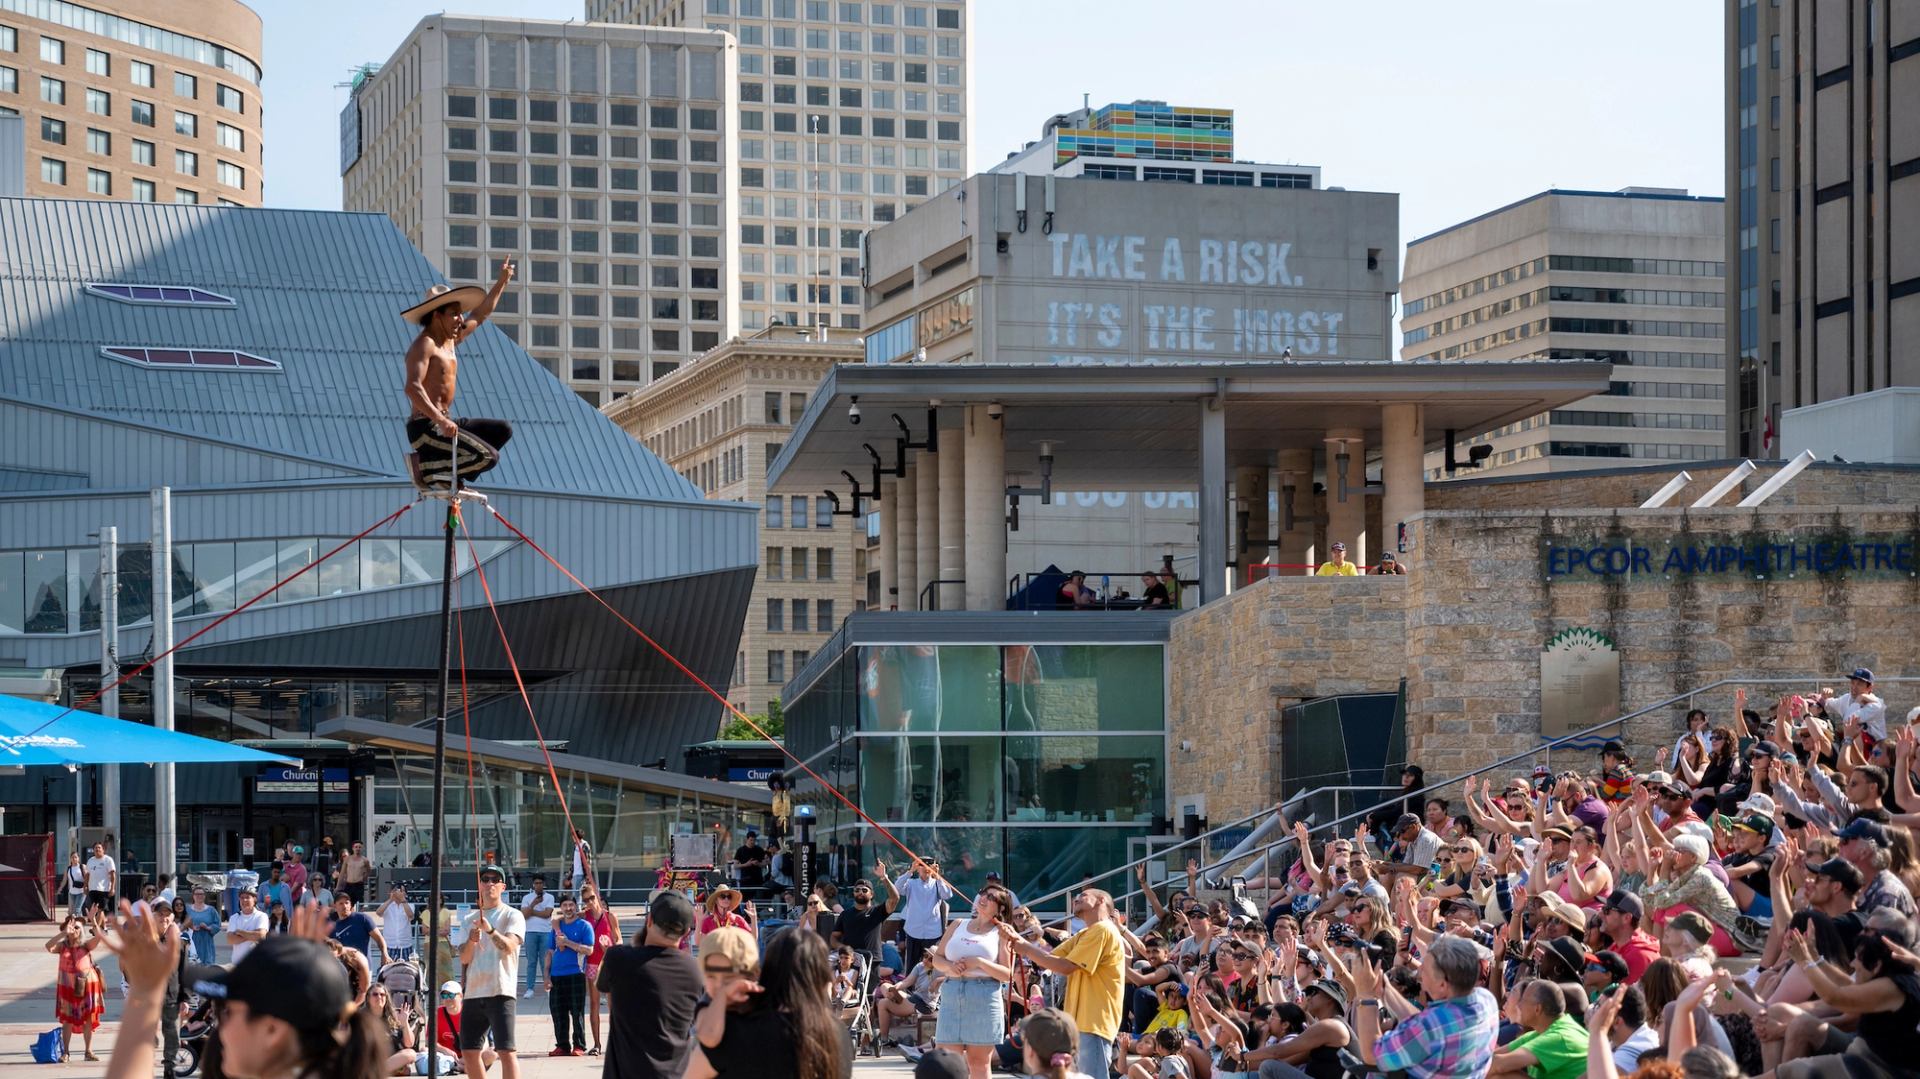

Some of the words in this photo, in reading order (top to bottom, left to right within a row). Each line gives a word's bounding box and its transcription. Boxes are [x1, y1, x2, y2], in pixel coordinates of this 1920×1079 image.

[1048, 232, 1146, 280] TAKE
[1160, 237, 1186, 281] A
[1199, 239, 1304, 287] RISK.
[1047, 301, 1122, 347] IT'S
[1143, 304, 1216, 350] THE
[1232, 308, 1344, 355] MOST
[1549, 546, 1651, 575] EPCOR
[1662, 543, 1914, 573] AMPHITHEATRE
[282, 769, 325, 780] Churchi
[801, 845, 809, 898] Security
